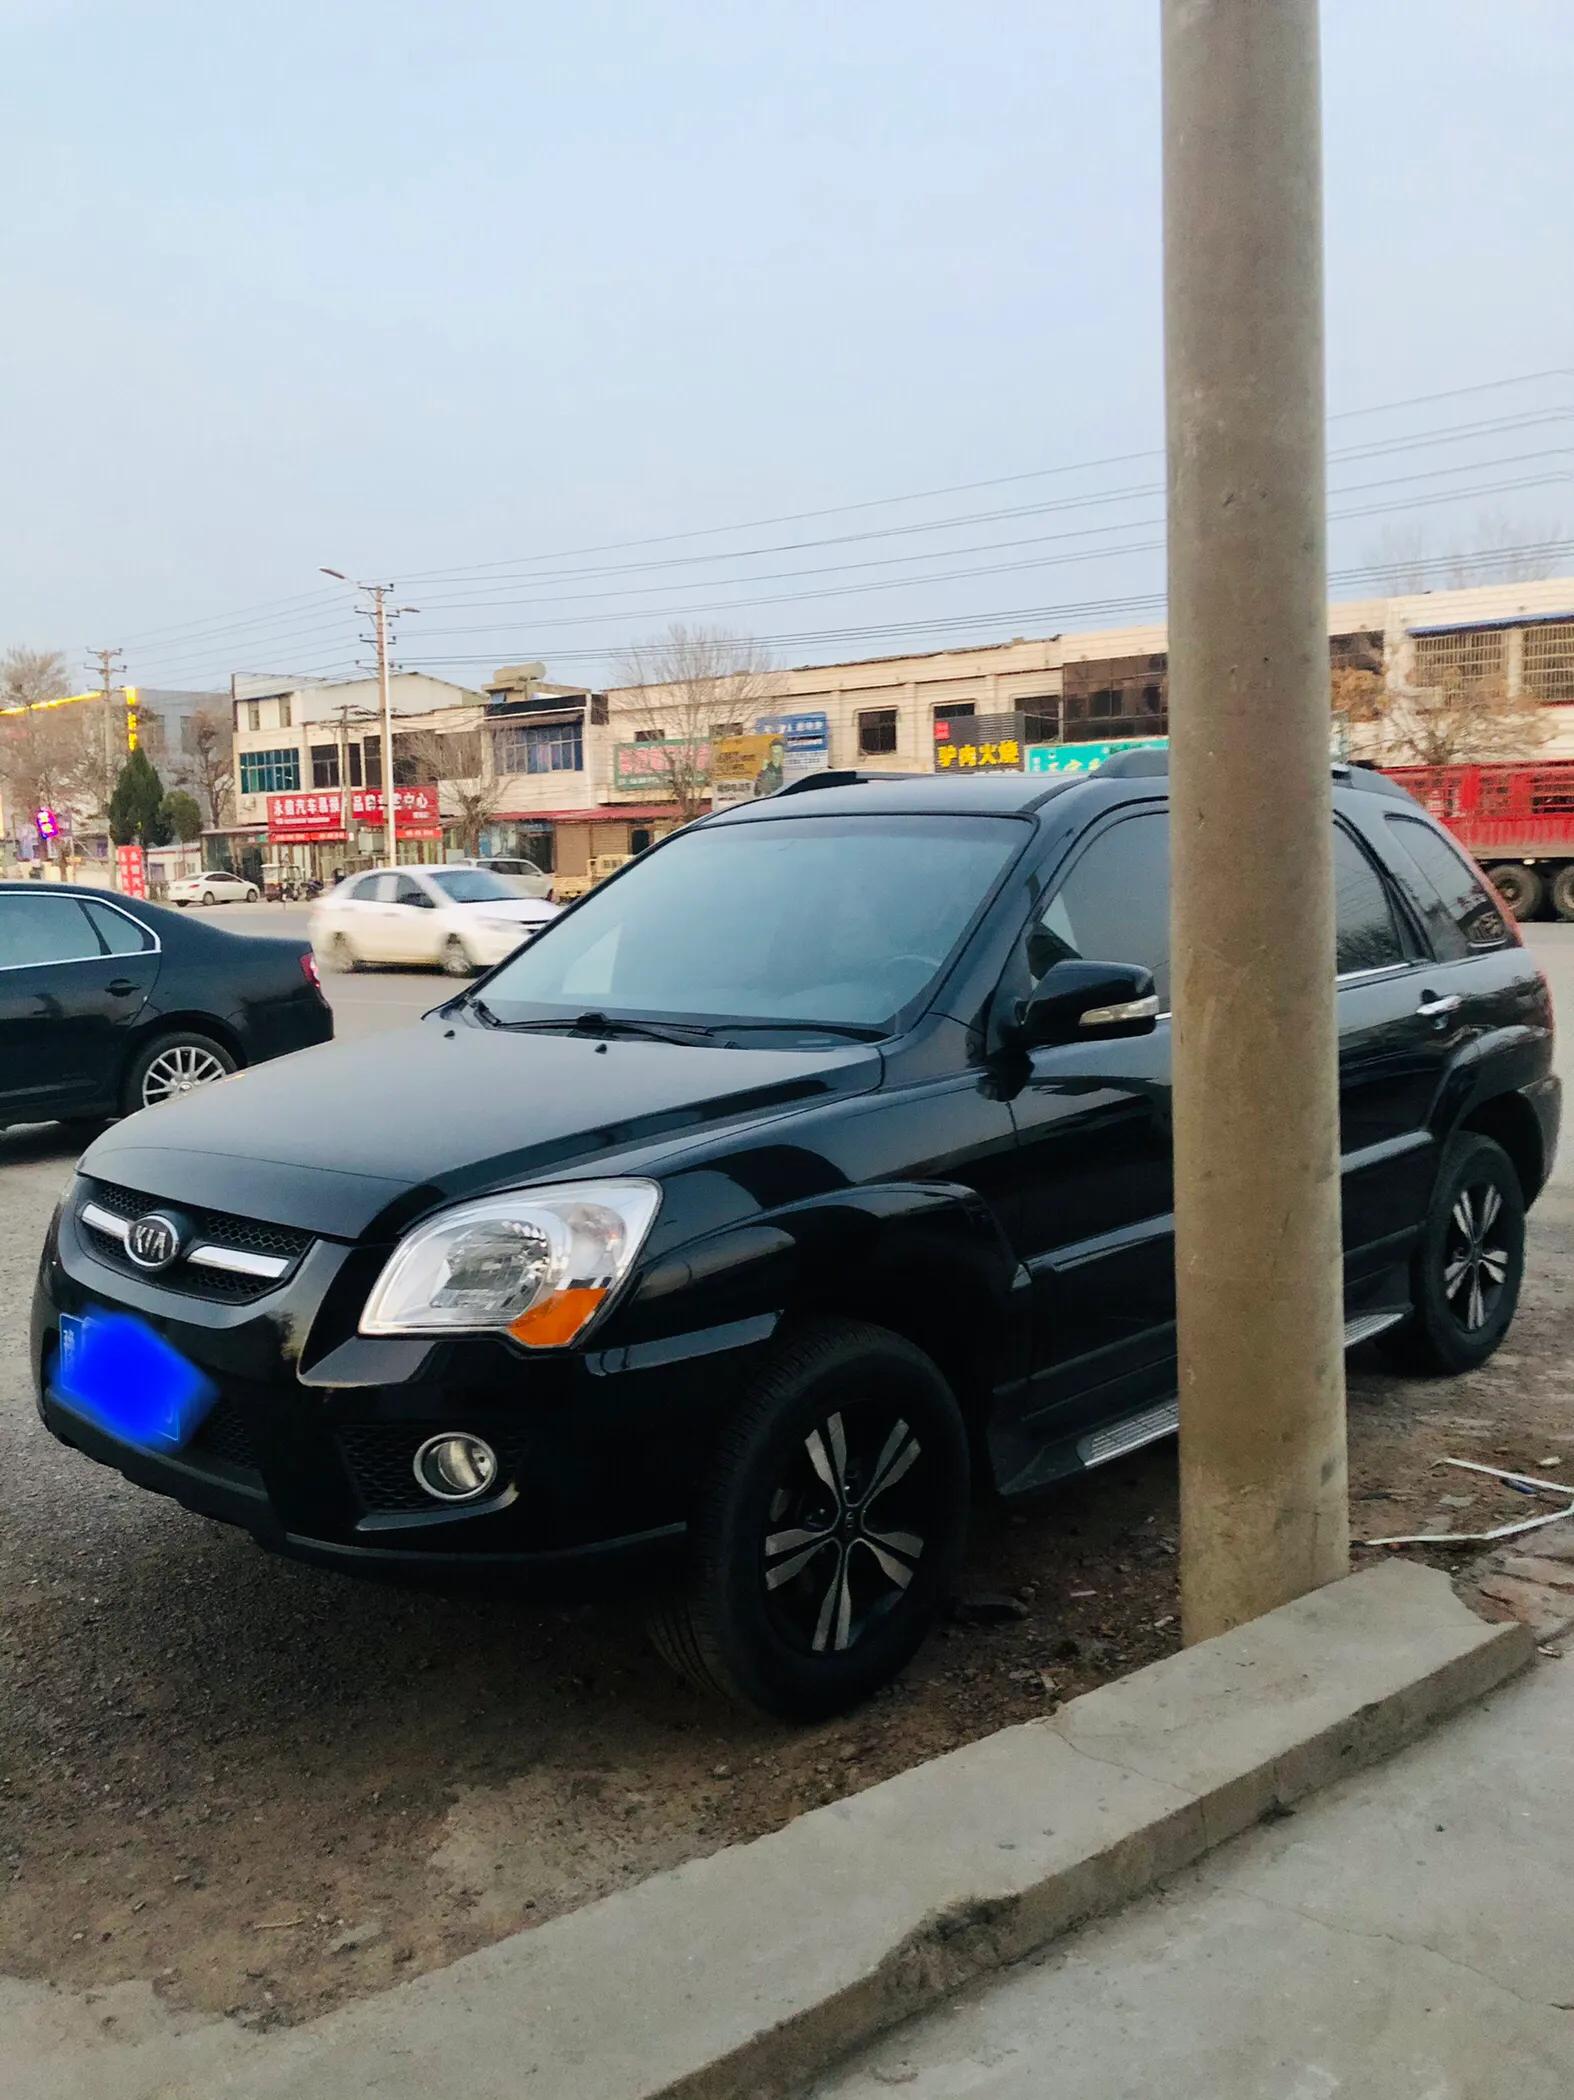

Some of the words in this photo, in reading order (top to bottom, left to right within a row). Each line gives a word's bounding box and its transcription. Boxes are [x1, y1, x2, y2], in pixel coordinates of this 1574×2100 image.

[937, 739, 1020, 768] 驴肉火烧
[136, 1225, 167, 1260] KIA
